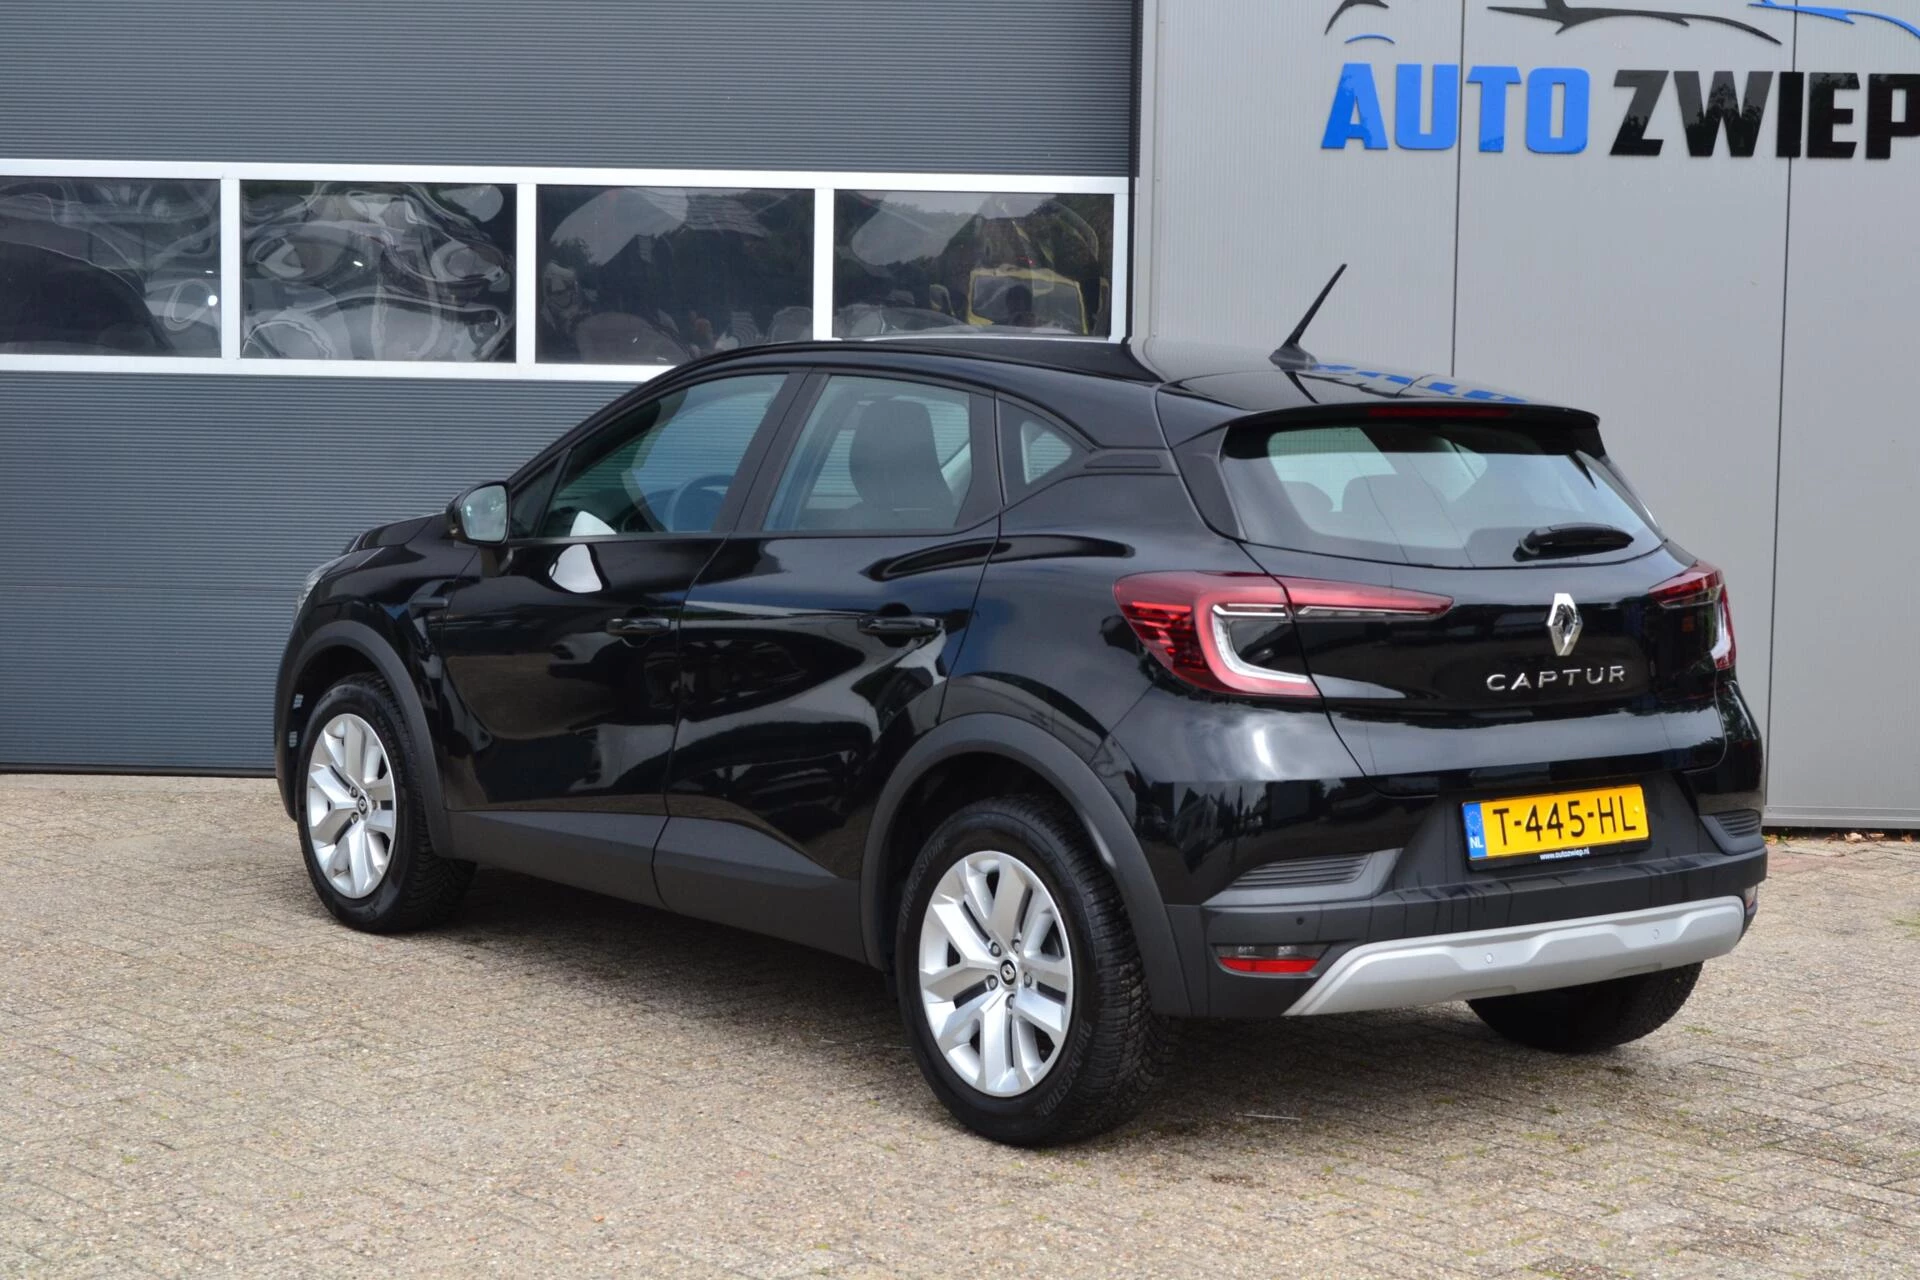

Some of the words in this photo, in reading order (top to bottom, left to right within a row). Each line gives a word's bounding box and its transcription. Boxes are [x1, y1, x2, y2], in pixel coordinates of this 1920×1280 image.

[1321, 63, 1590, 155] AUTO
[1609, 70, 1920, 160] ZWIEP
[1486, 665, 1626, 691] CAPTUR
[1492, 795, 1637, 846] T-445-HL
[1469, 835, 1484, 849] NL
